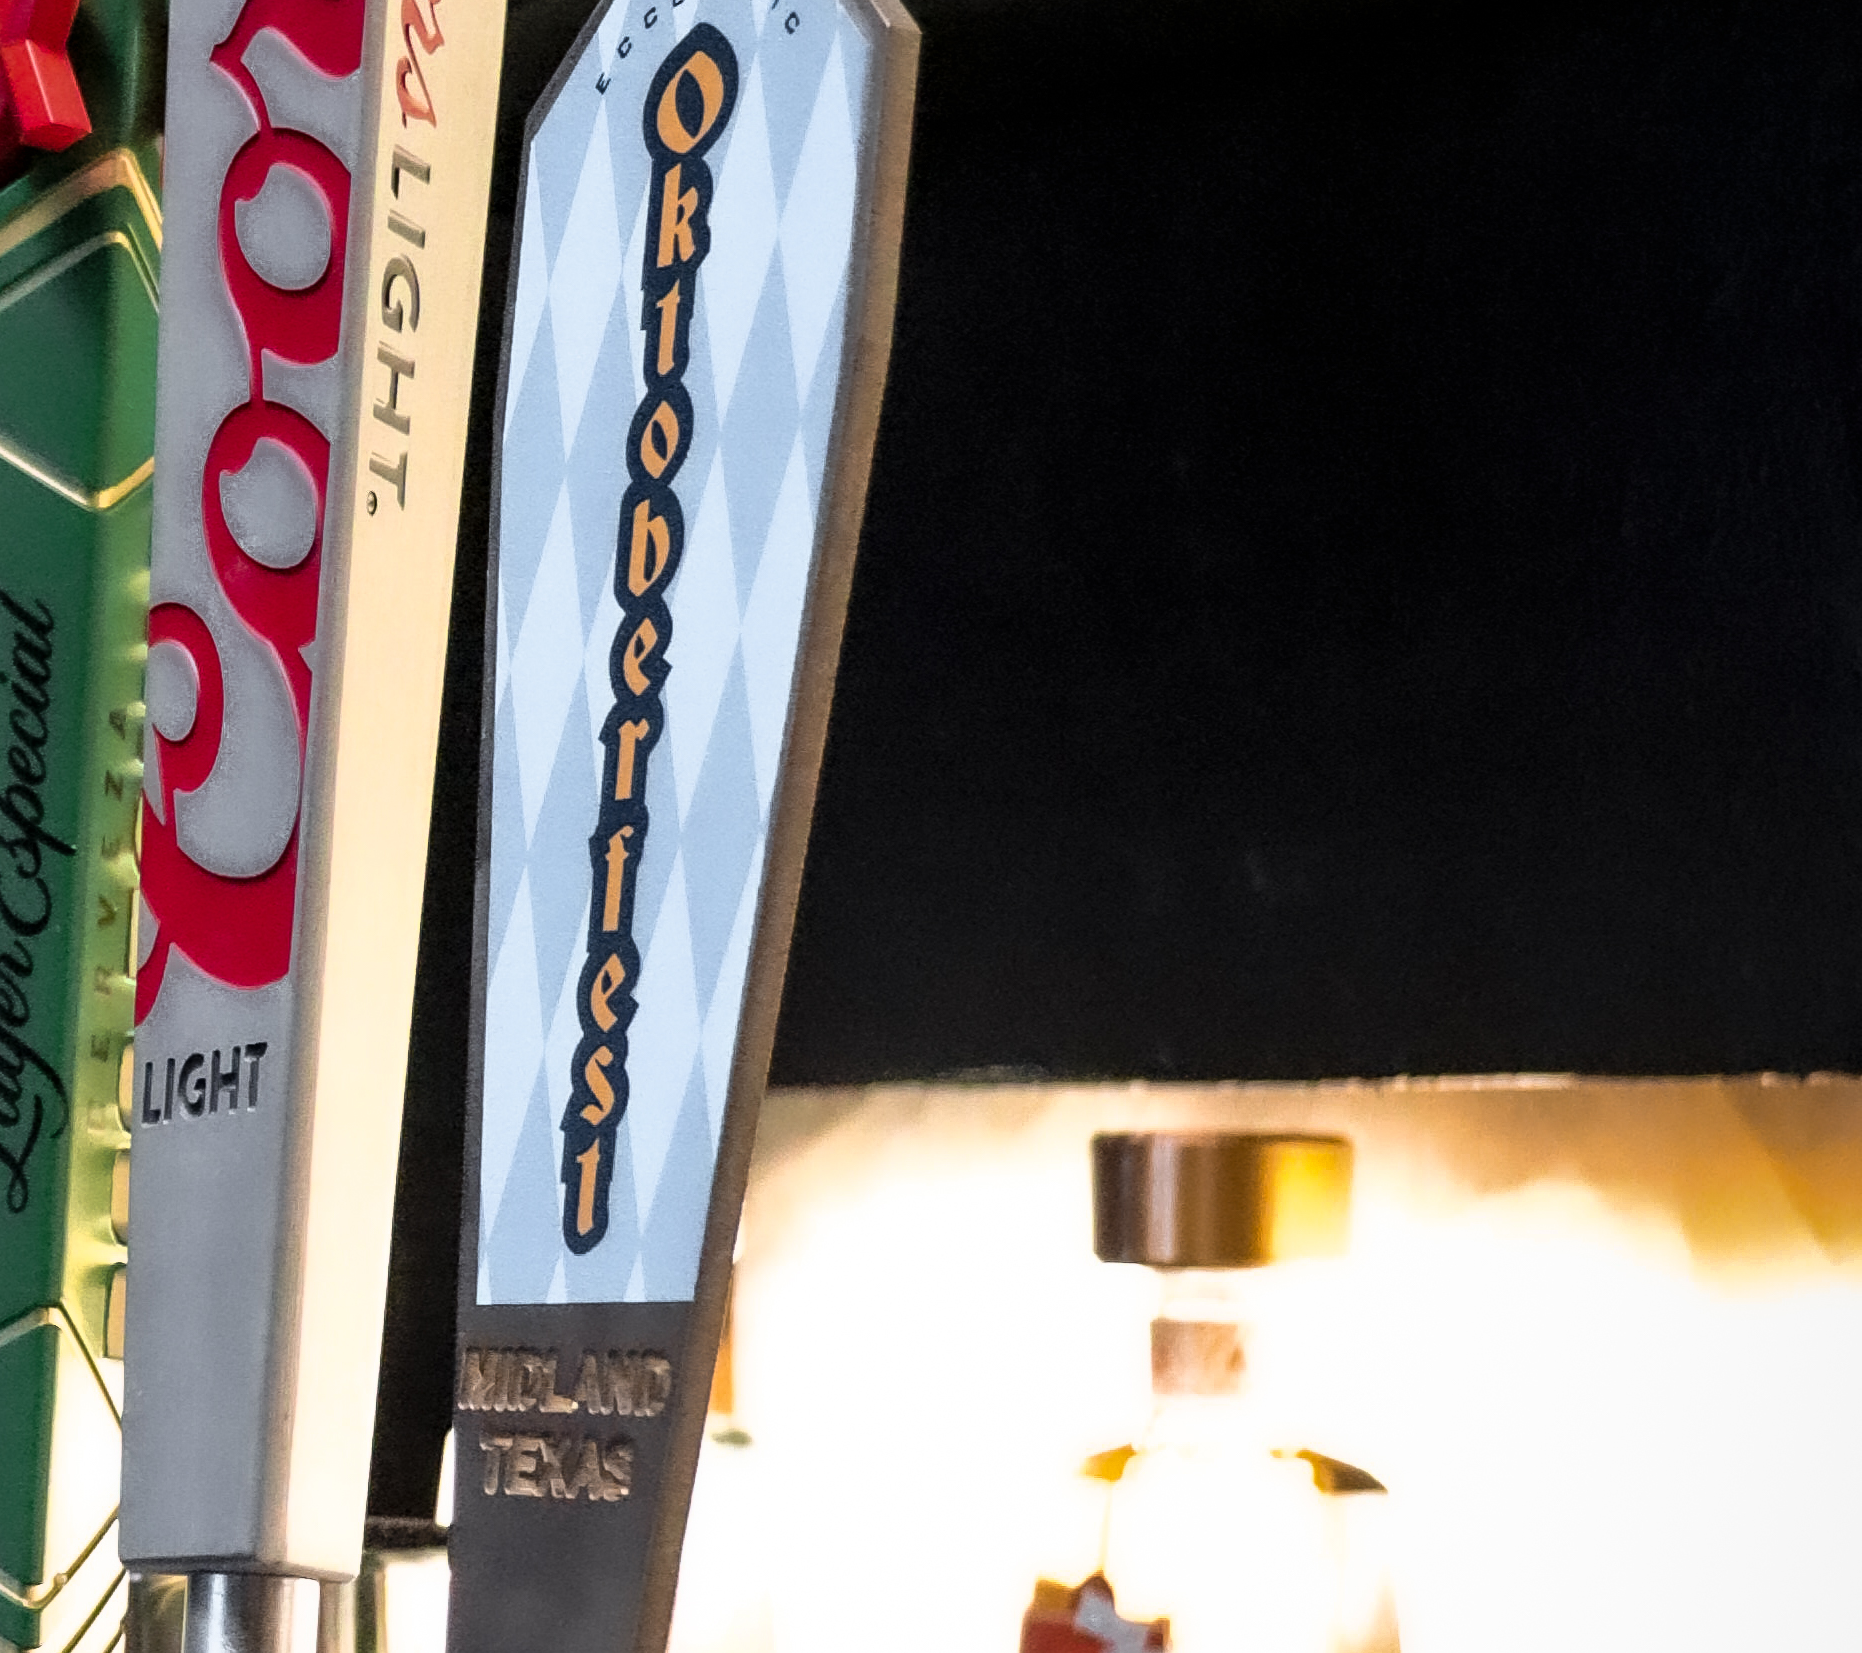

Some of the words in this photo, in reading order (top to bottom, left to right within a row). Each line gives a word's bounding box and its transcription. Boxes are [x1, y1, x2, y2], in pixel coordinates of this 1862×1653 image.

[571, 41, 730, 1238] Oktoberfest
[142, 1039, 269, 1129] LIGHT
[456, 1346, 672, 1418] MIDLAND
[478, 1436, 635, 1502] TEXAS
